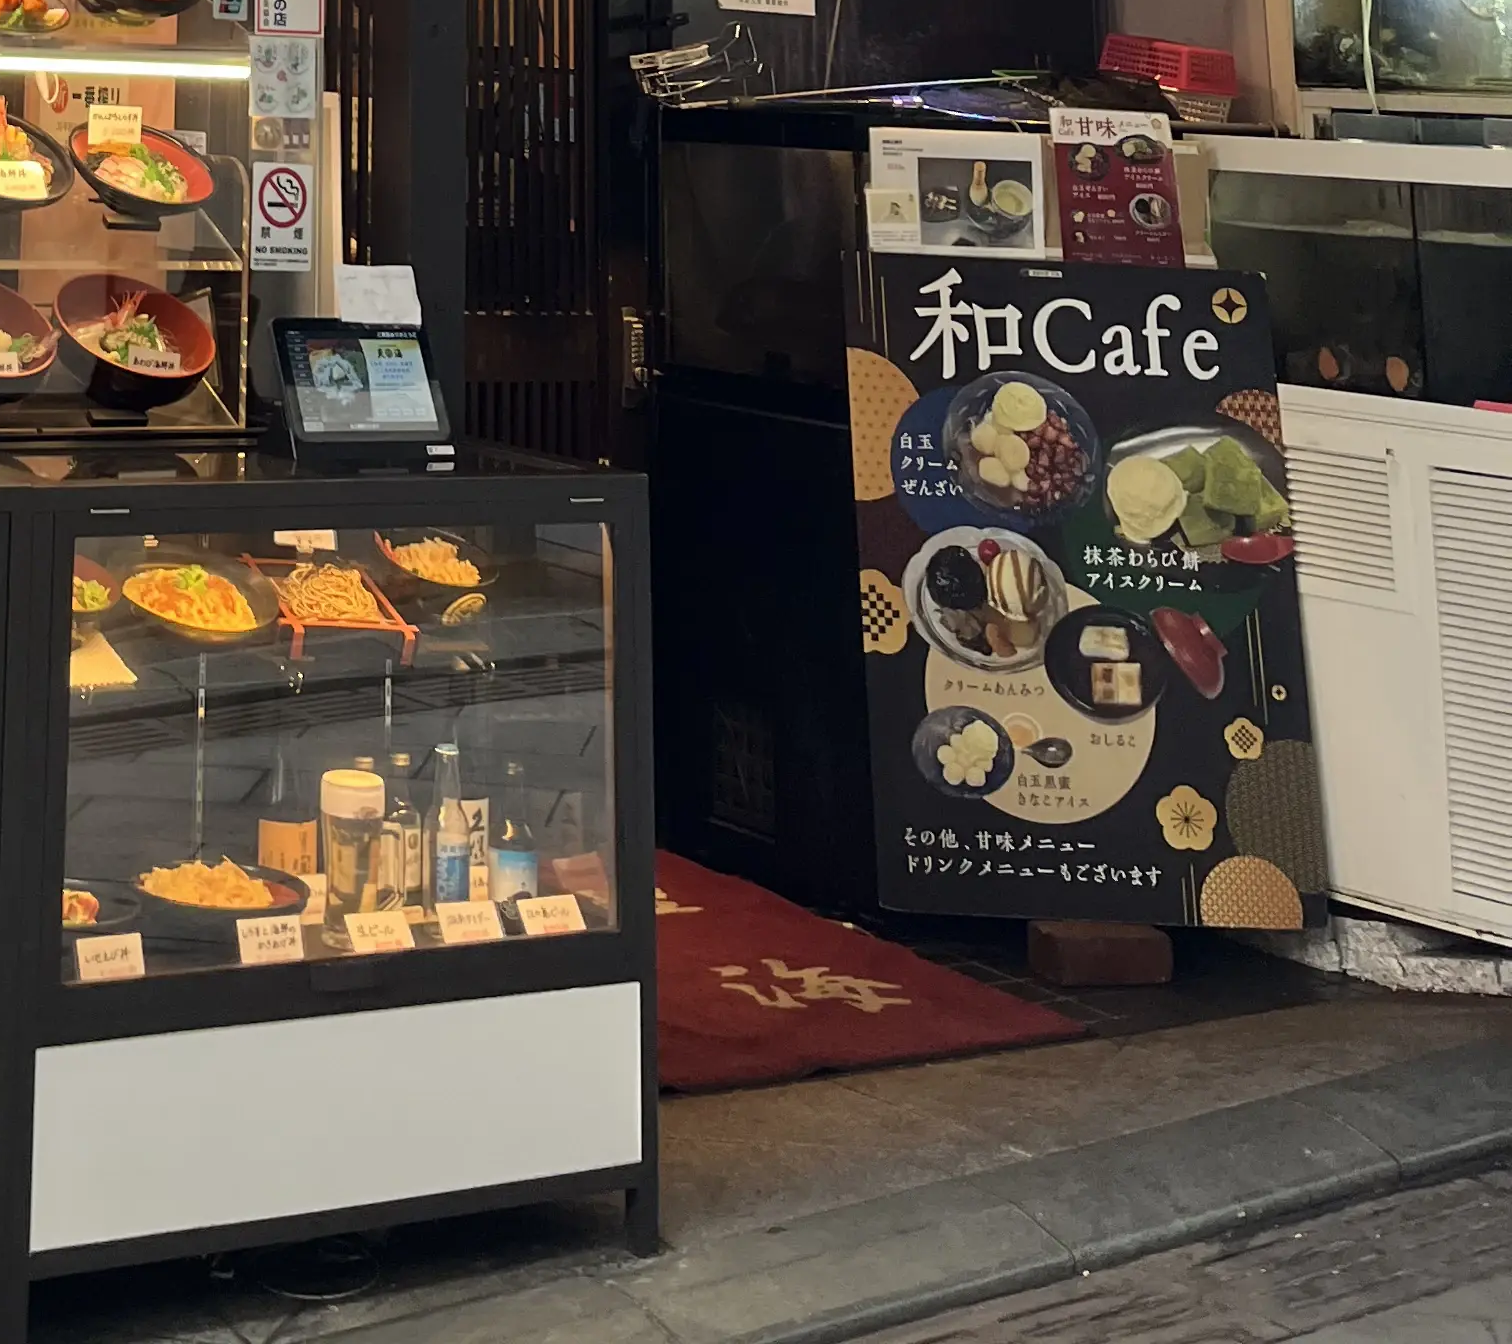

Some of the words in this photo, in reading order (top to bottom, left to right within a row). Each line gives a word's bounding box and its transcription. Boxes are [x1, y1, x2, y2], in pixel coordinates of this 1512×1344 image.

[1075, 116, 1119, 139] 甘味
[255, 245, 268, 255] NO
[269, 245, 309, 256] SMOKING
[908, 266, 1222, 381] 和Cafe
[899, 431, 934, 452] 白玉
[899, 455, 959, 473] クリーム
[900, 477, 964, 498] ぜんざい
[1083, 544, 1201, 572] 抹茶わらび餅
[1085, 571, 1203, 593] アイスクリーム
[942, 678, 1046, 697] クリームあんみつ
[1089, 731, 1138, 749] おしるこ
[1016, 773, 1072, 791] 白玉黒蜜
[1016, 791, 1091, 810] きなこアイス
[902, 826, 1096, 853] その他、甘味メニュー
[904, 855, 1163, 888] ドリンクメニューもございます
